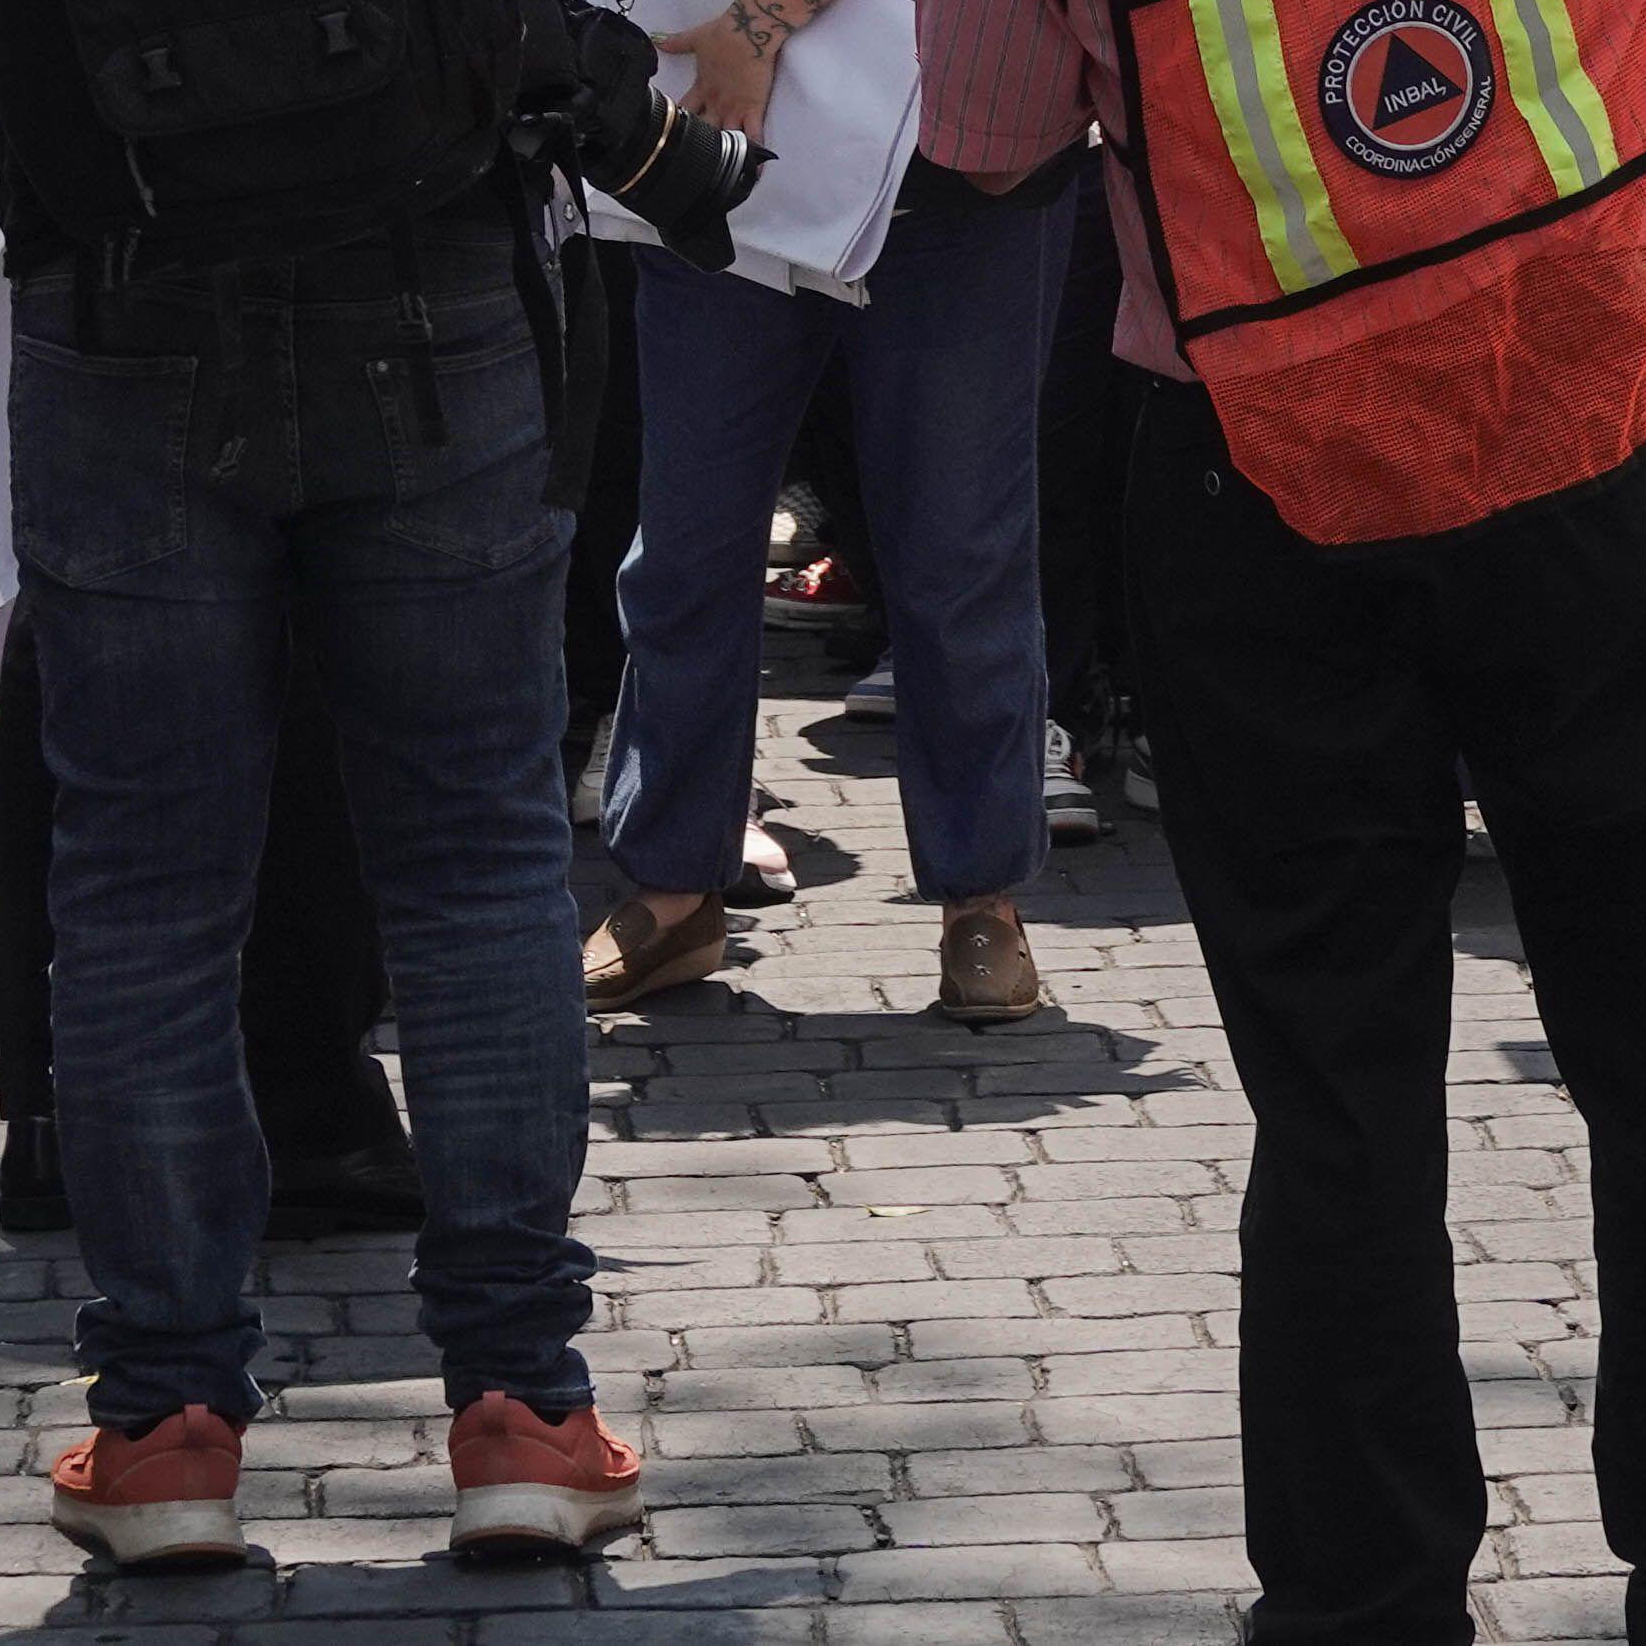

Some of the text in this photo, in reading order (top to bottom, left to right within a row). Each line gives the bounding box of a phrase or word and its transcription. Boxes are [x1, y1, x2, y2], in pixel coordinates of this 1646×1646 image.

[1432, 4, 1477, 52] CIVIL
[1384, 76, 1447, 114] INBAL
[1345, 75, 1492, 173] COORDINACIÓN GENERAL
